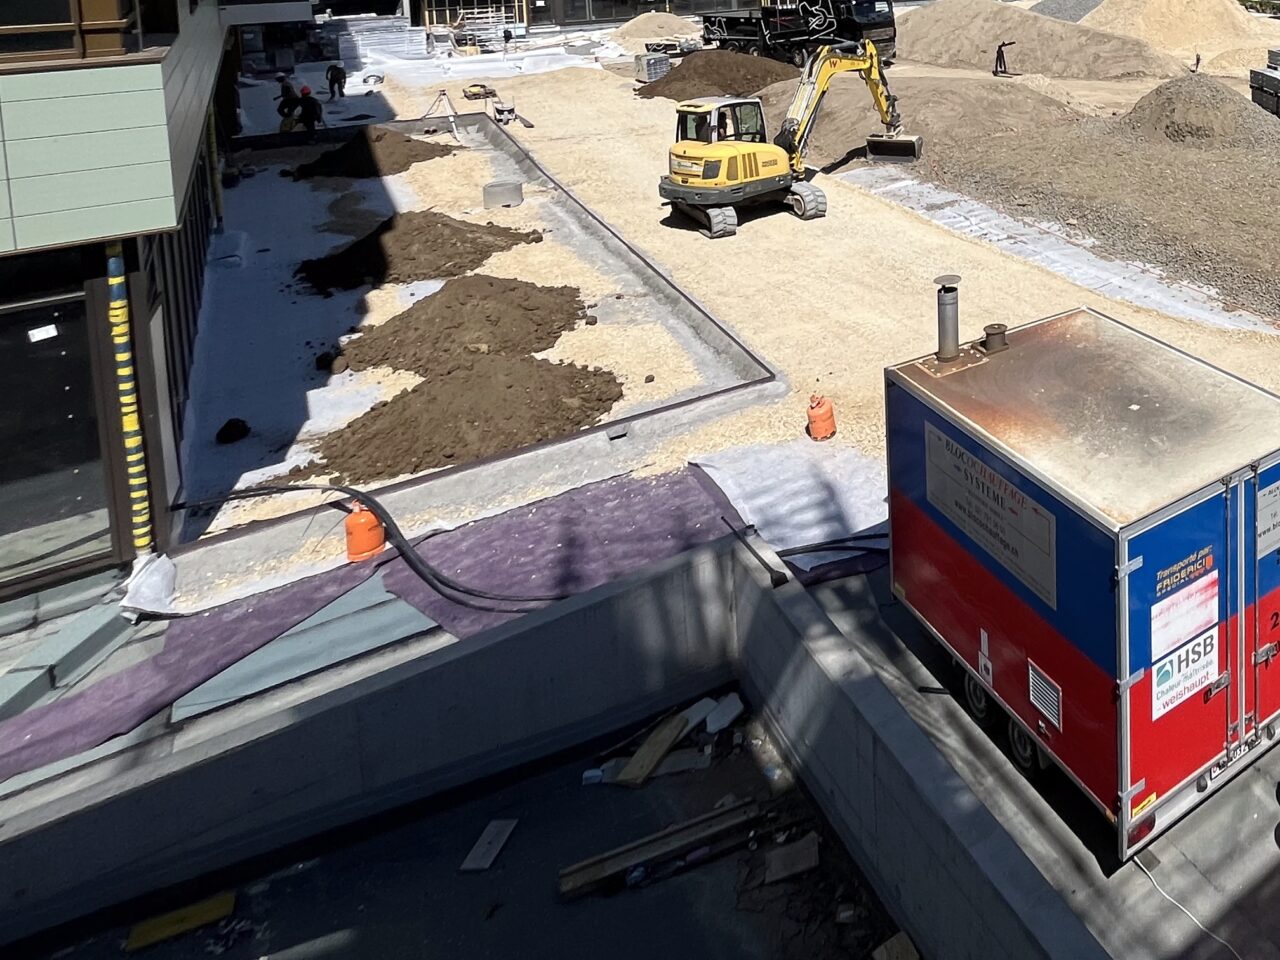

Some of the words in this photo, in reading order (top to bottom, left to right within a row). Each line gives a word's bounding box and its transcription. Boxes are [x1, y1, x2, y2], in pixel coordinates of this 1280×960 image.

[945, 439, 1027, 509] BLOCOCHAUFFAGE
[1156, 557, 1206, 592] FRIDERICI
[1177, 634, 1214, 674] HSB
[1156, 679, 1181, 701] Chaleur
